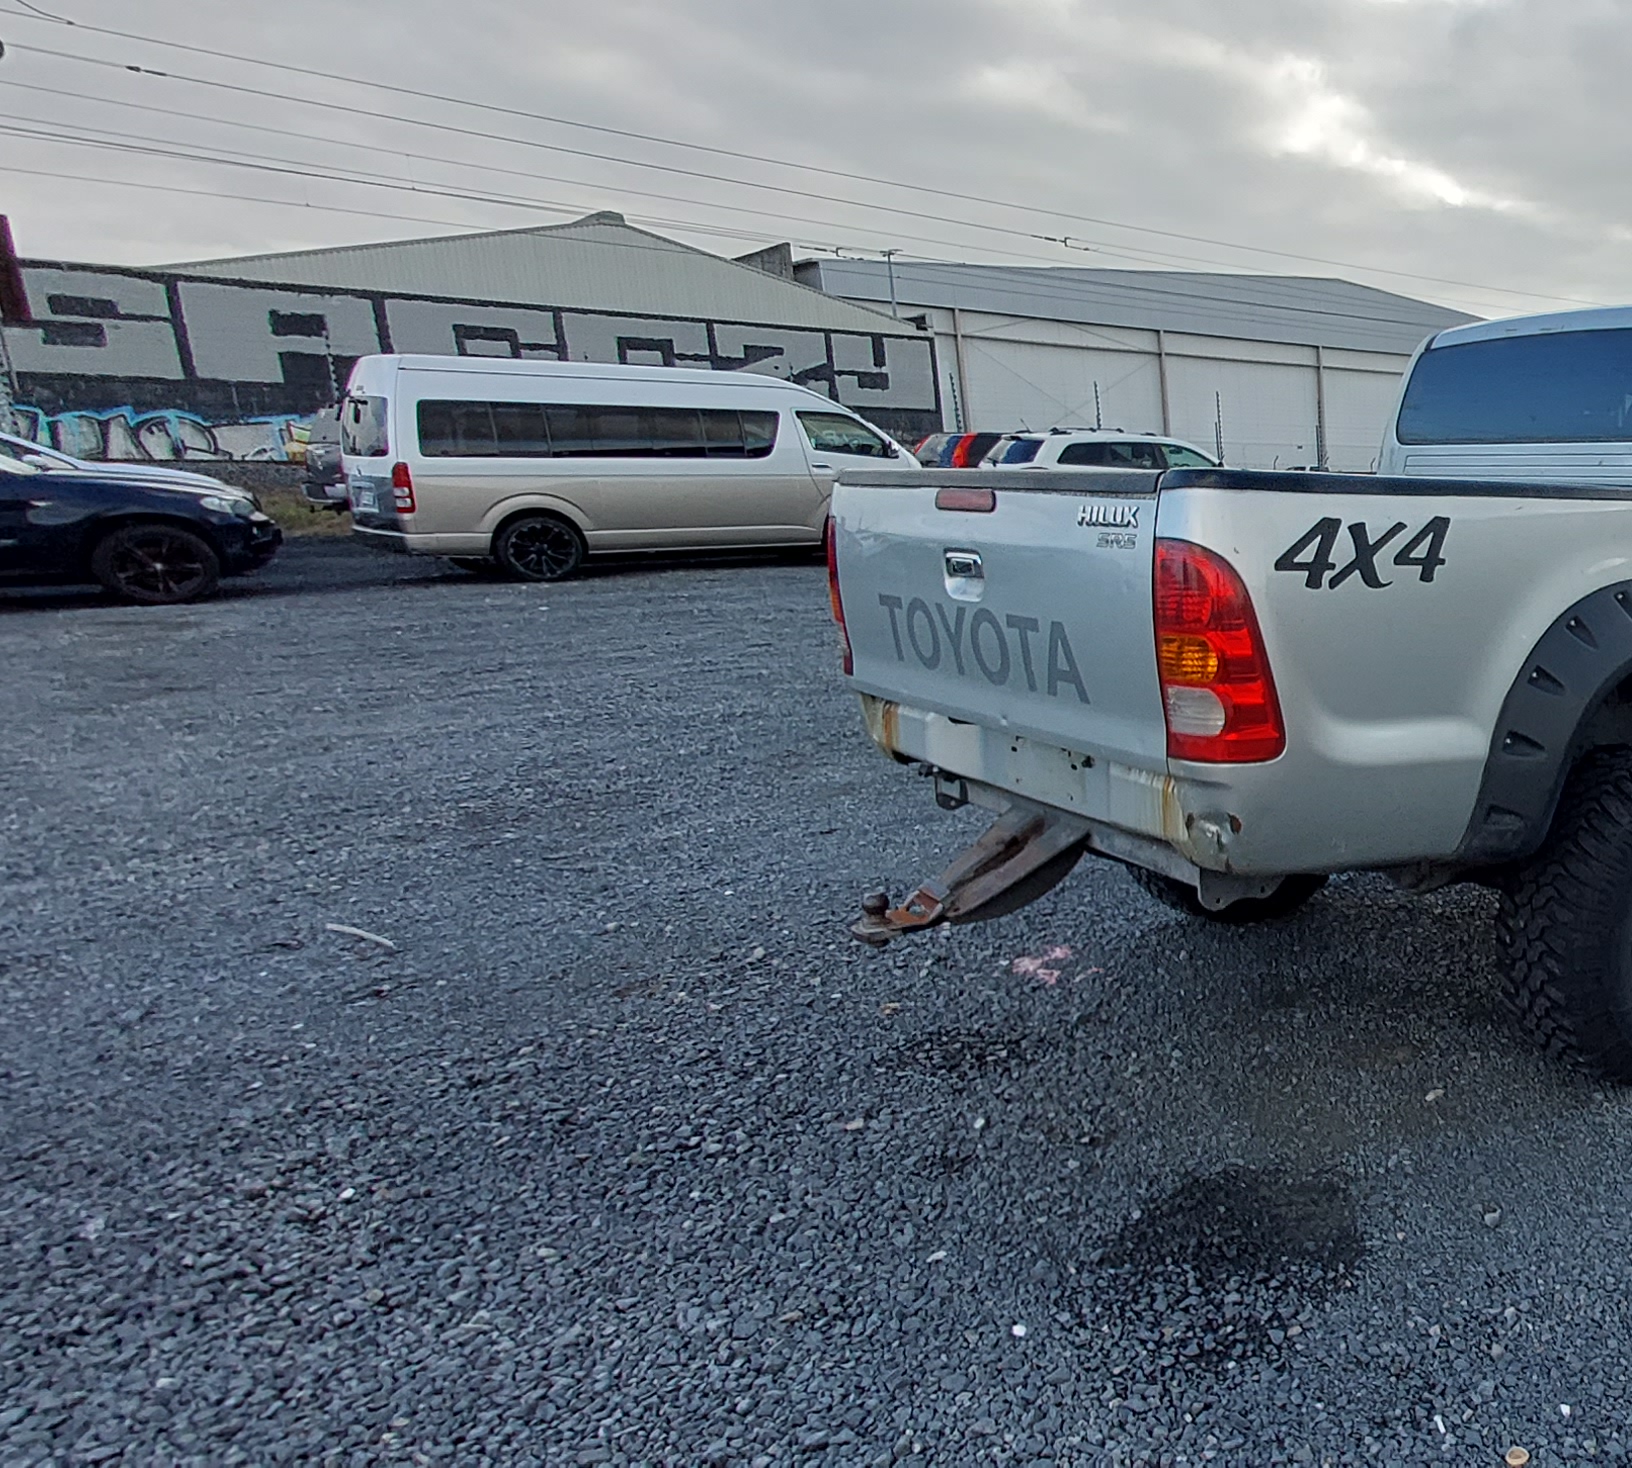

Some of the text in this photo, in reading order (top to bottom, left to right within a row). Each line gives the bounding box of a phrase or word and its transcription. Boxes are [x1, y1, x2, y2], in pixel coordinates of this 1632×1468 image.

[1077, 505, 1140, 528] HILUX
[1274, 516, 1451, 590] 4X4
[878, 592, 1091, 705] TOYOTA
